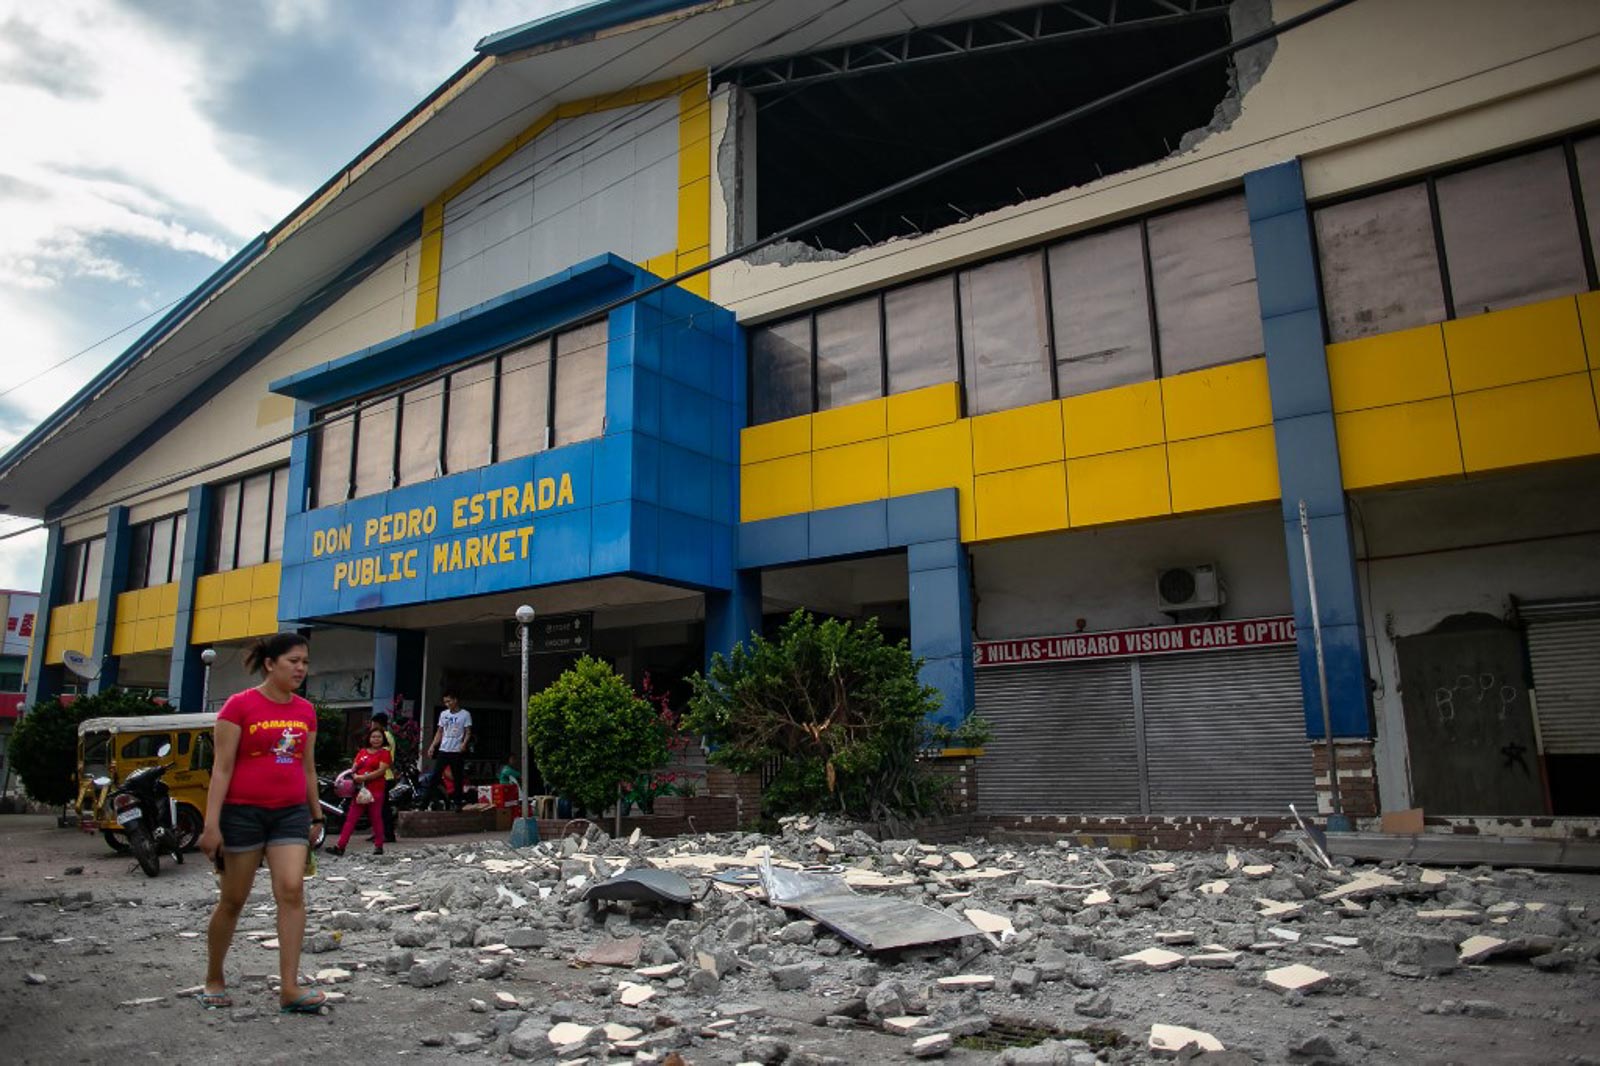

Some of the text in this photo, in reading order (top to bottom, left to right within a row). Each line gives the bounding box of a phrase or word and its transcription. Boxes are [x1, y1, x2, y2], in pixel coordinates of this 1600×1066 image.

[312, 472, 574, 558] DON PEDRO ESTRADA
[333, 526, 535, 590] PUBLIC MARKET
[988, 635, 1120, 663] NILLAS-LIMBARO
[1126, 629, 1184, 652] VISION
[1190, 624, 1238, 647] CARE
[1243, 619, 1297, 642] OPTIC
